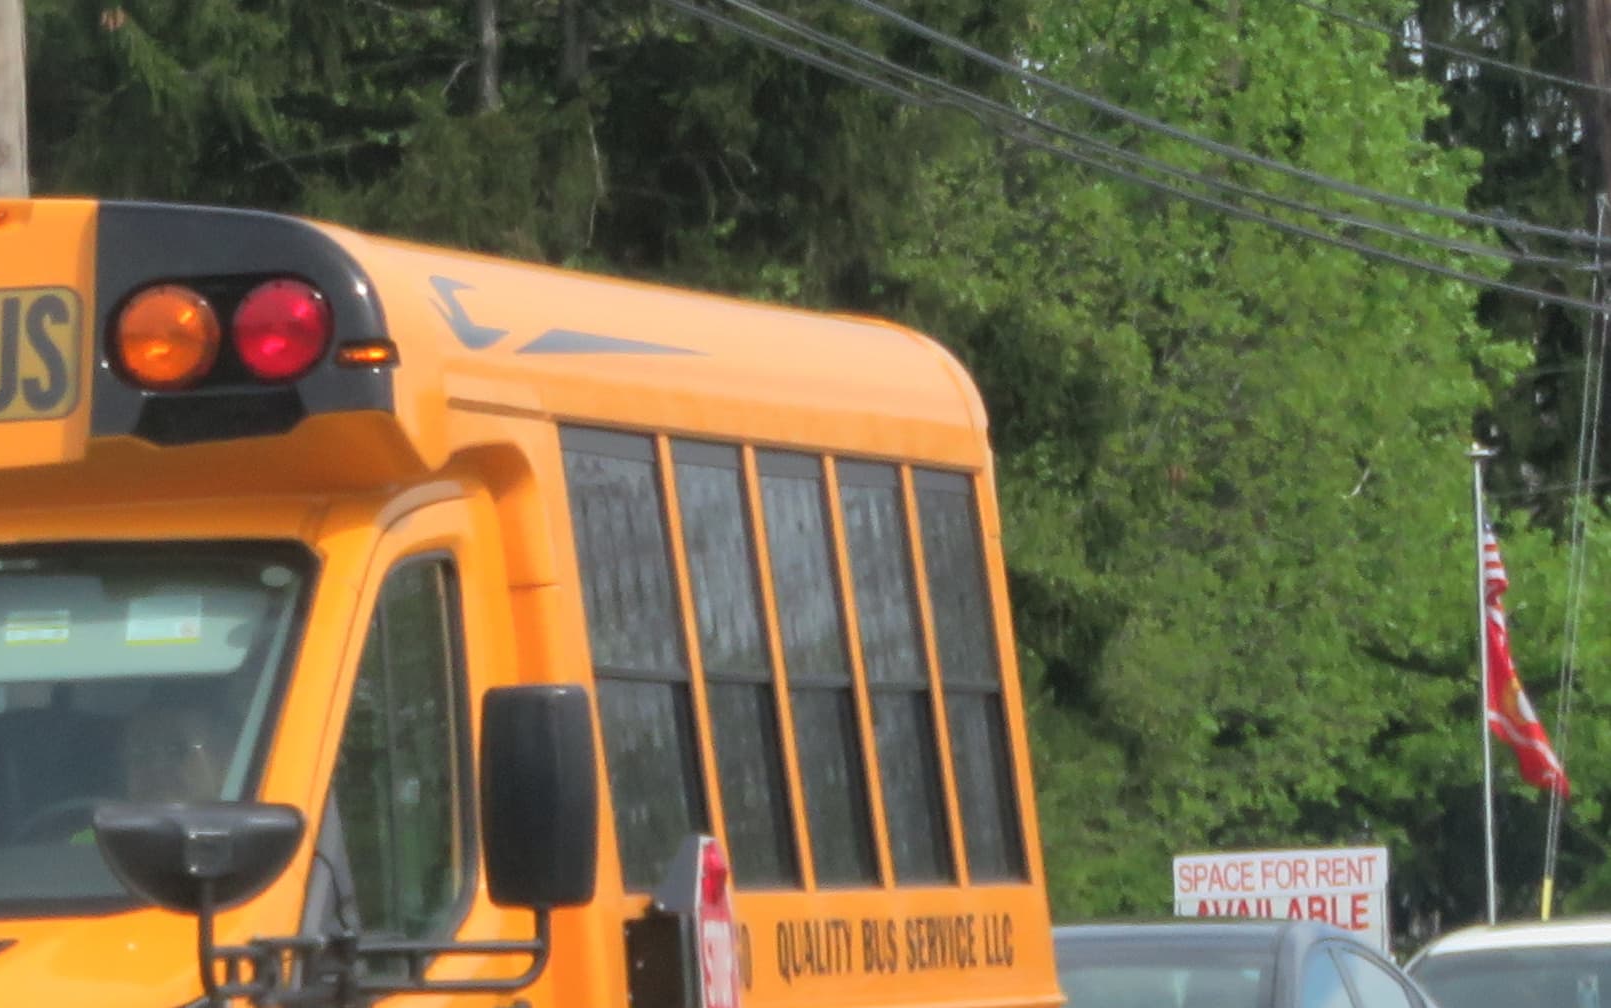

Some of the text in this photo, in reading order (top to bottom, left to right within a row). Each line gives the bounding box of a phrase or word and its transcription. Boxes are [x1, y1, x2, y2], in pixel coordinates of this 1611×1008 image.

[1178, 855, 1377, 893] SPACE FOR RENT
[776, 917, 853, 985] QUALITY
[861, 917, 898, 974] BUS
[904, 913, 978, 974] SERVICE
[984, 911, 1014, 968] LLC
